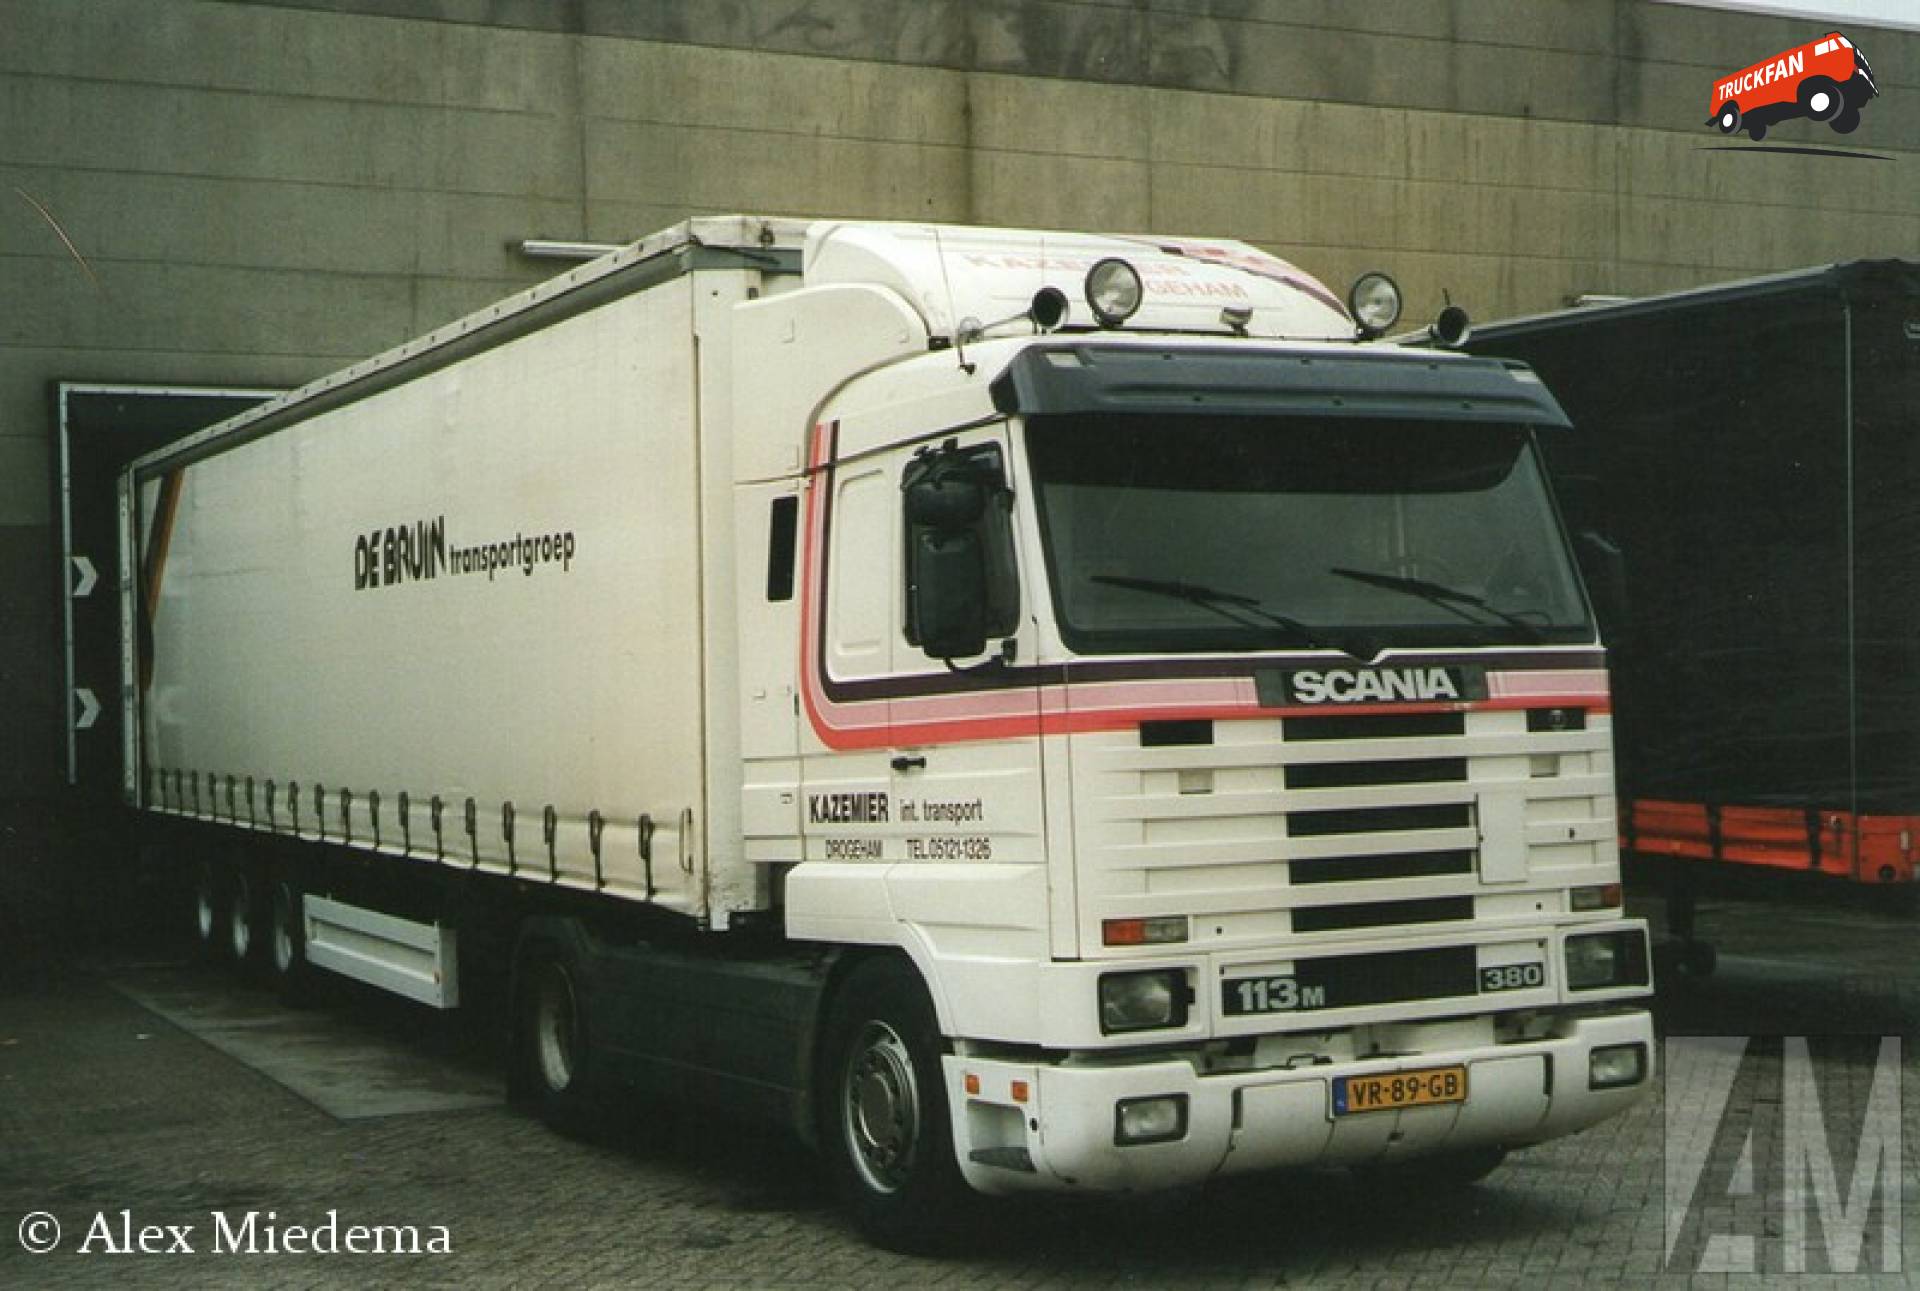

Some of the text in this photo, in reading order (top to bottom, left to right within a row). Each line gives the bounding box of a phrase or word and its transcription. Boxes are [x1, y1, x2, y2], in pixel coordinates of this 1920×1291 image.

[355, 515, 576, 591] DE BRUIN transportgroep
[1292, 667, 1458, 703] SCANIA
[808, 792, 984, 826] KAZEMIER int. transport
[825, 839, 883, 860] DROGEHAM
[1485, 965, 1543, 990] 380
[1237, 978, 1325, 1013] 113 M
[1352, 1074, 1458, 1107] VR-89-GB
